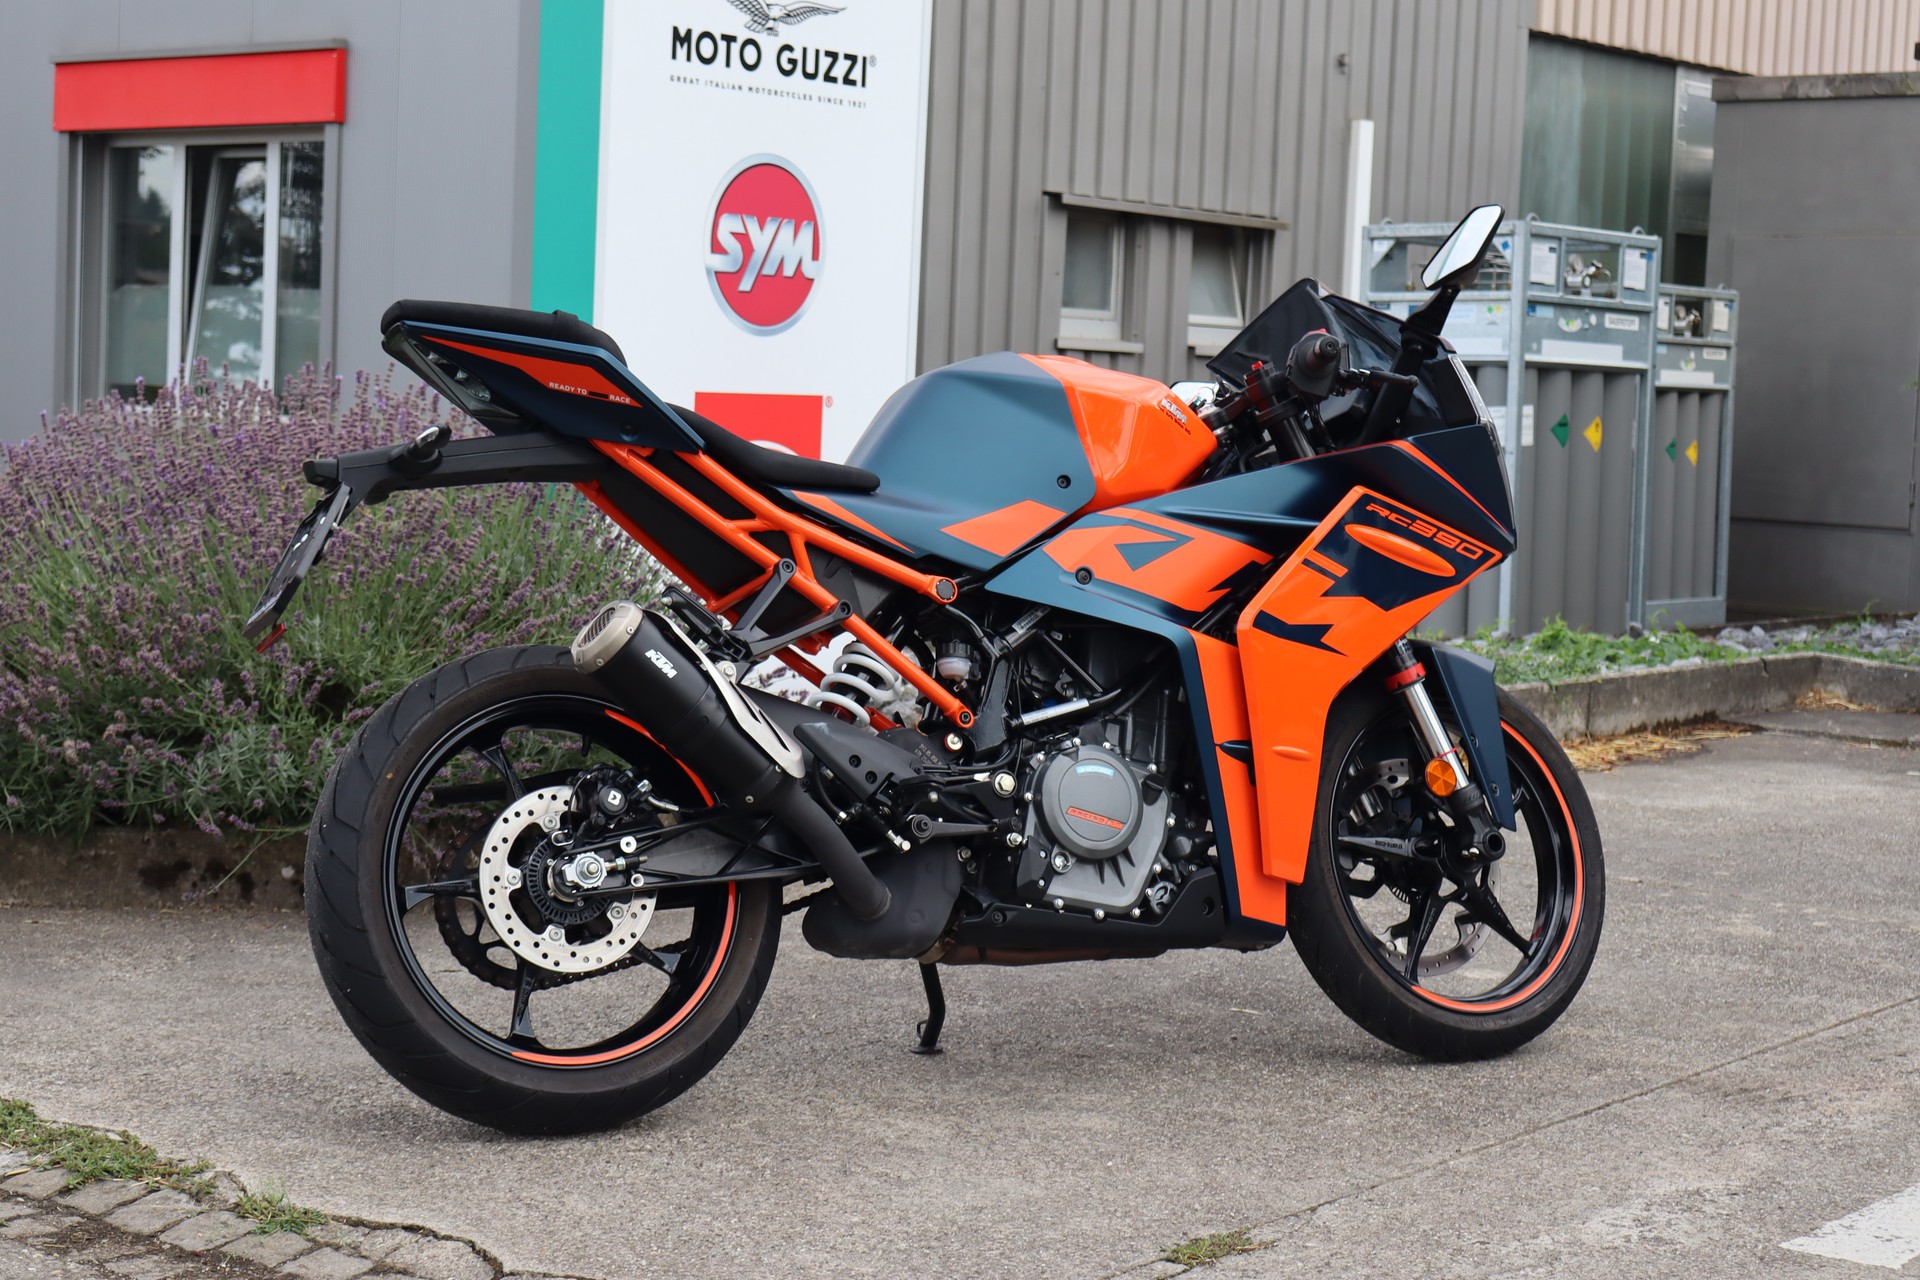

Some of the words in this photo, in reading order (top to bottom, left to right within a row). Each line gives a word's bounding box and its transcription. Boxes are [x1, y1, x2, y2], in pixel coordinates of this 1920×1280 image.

[671, 25, 762, 72] MOTO
[776, 43, 867, 88] GUZZI
[670, 75, 700, 85] GREAT
[705, 80, 743, 92] ITALIAN
[748, 86, 813, 101] MOTORCYCLES
[818, 95, 843, 106] SINCE
[848, 101, 866, 109] 1921
[705, 213, 824, 293] SYM
[549, 382, 575, 392] READY
[576, 387, 587, 395] TO
[609, 394, 631, 404] RACE
[644, 648, 678, 679] KTM
